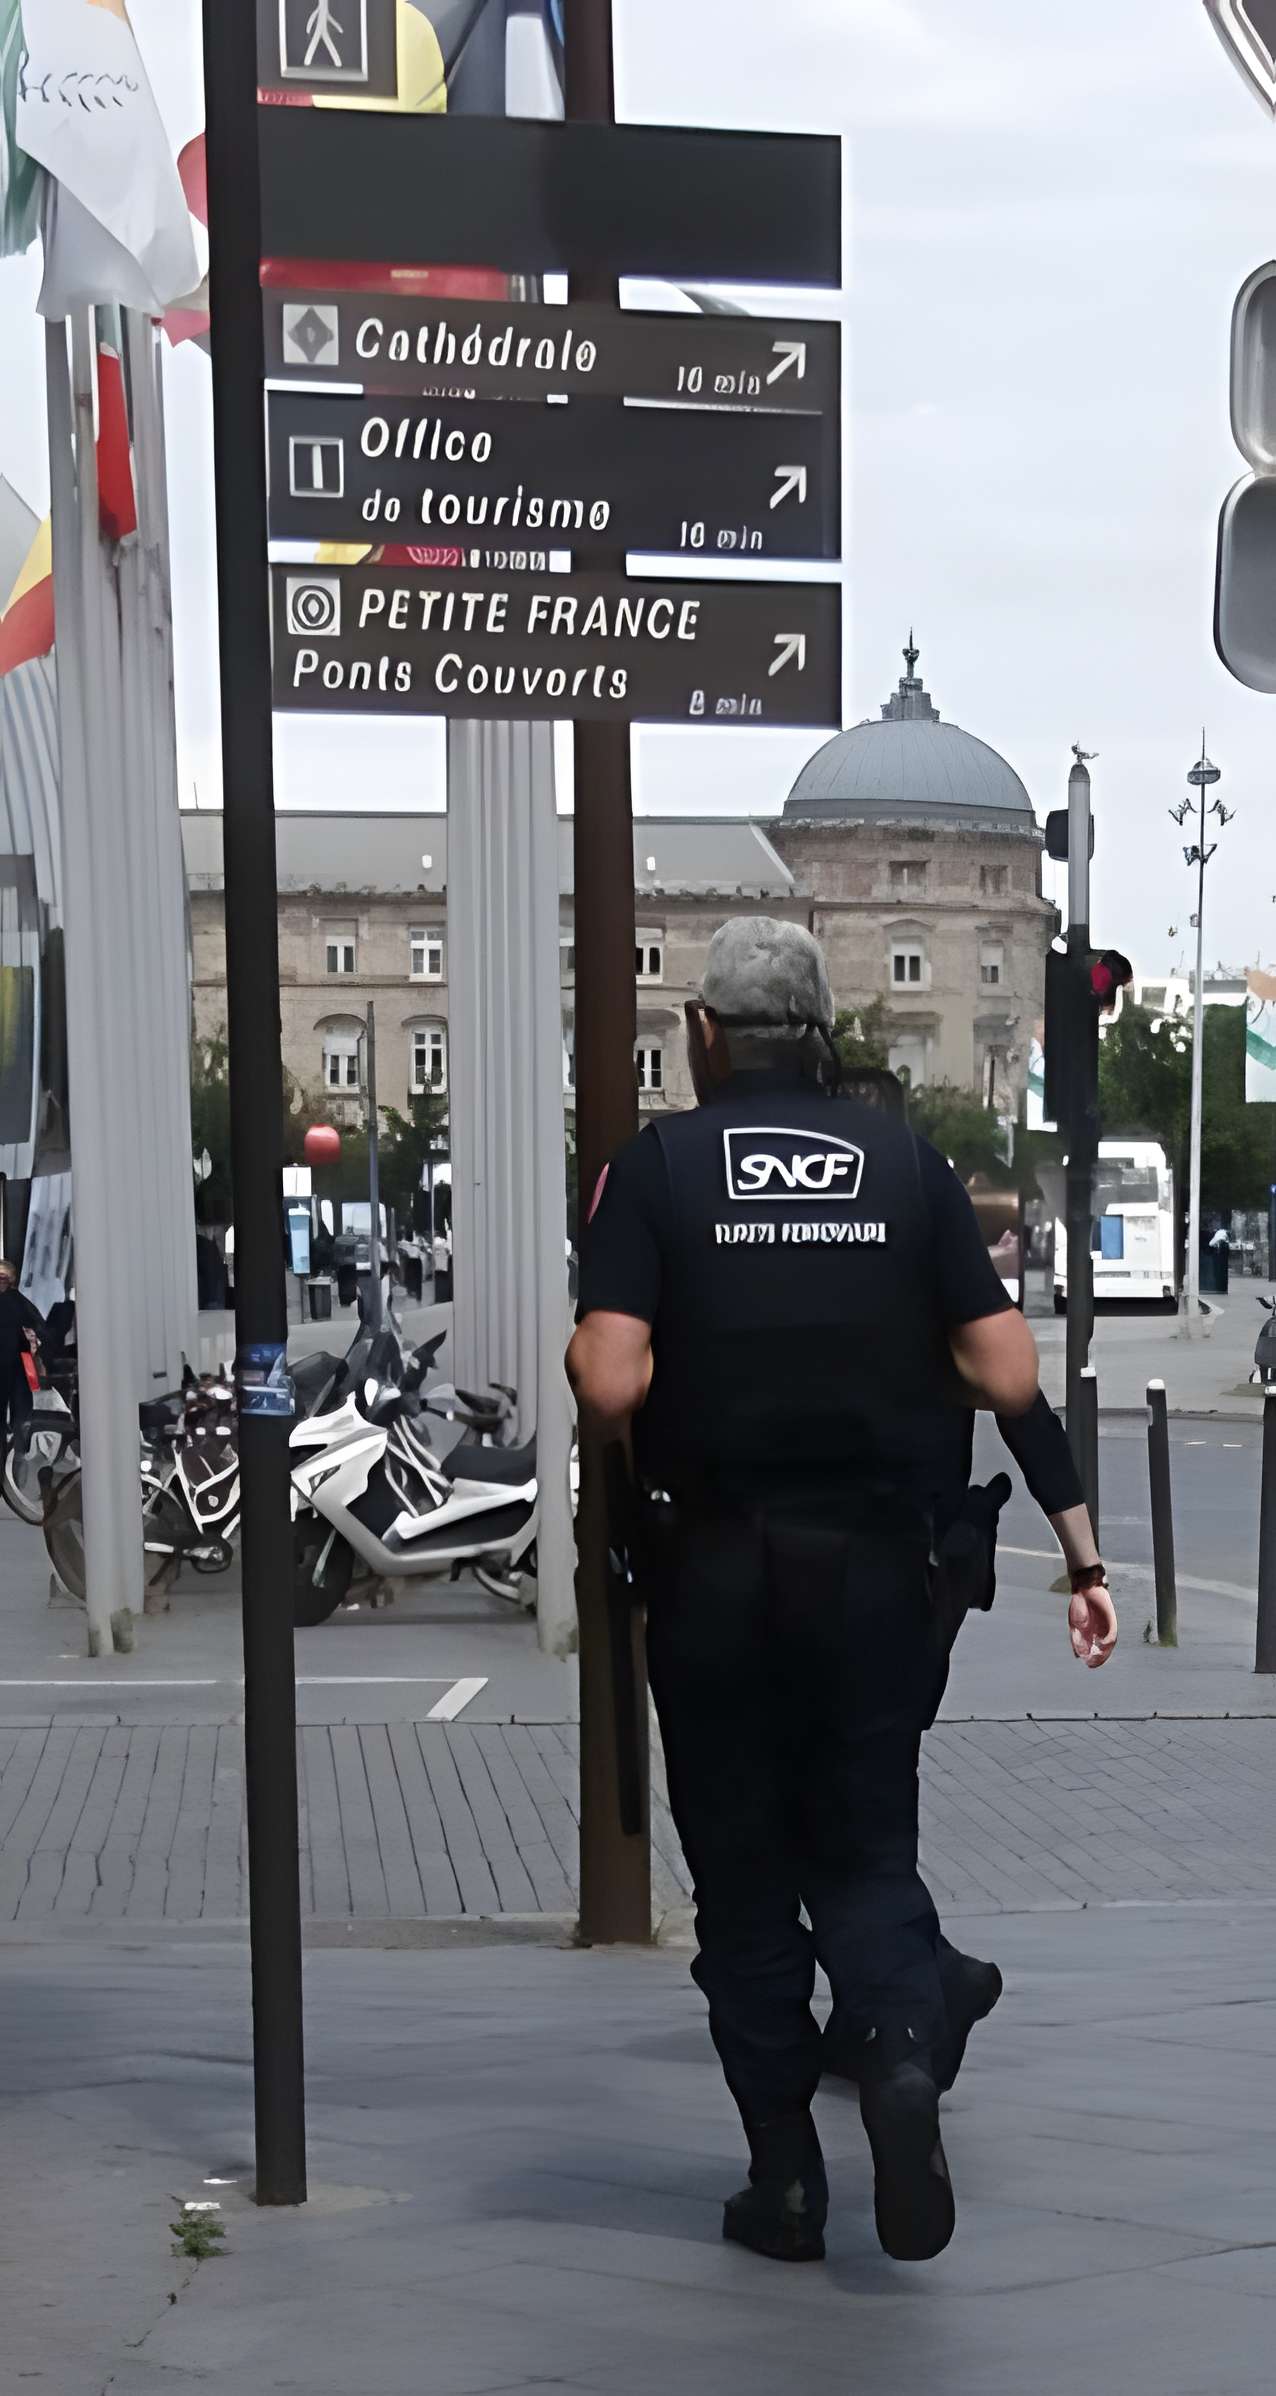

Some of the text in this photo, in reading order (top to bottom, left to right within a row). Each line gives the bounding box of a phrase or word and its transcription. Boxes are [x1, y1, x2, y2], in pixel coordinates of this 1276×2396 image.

[677, 366, 703, 393] 10
[680, 521, 705, 548] 10
[359, 588, 701, 640] PETITE FRANCE
[736, 1153, 855, 1191] SNCF
